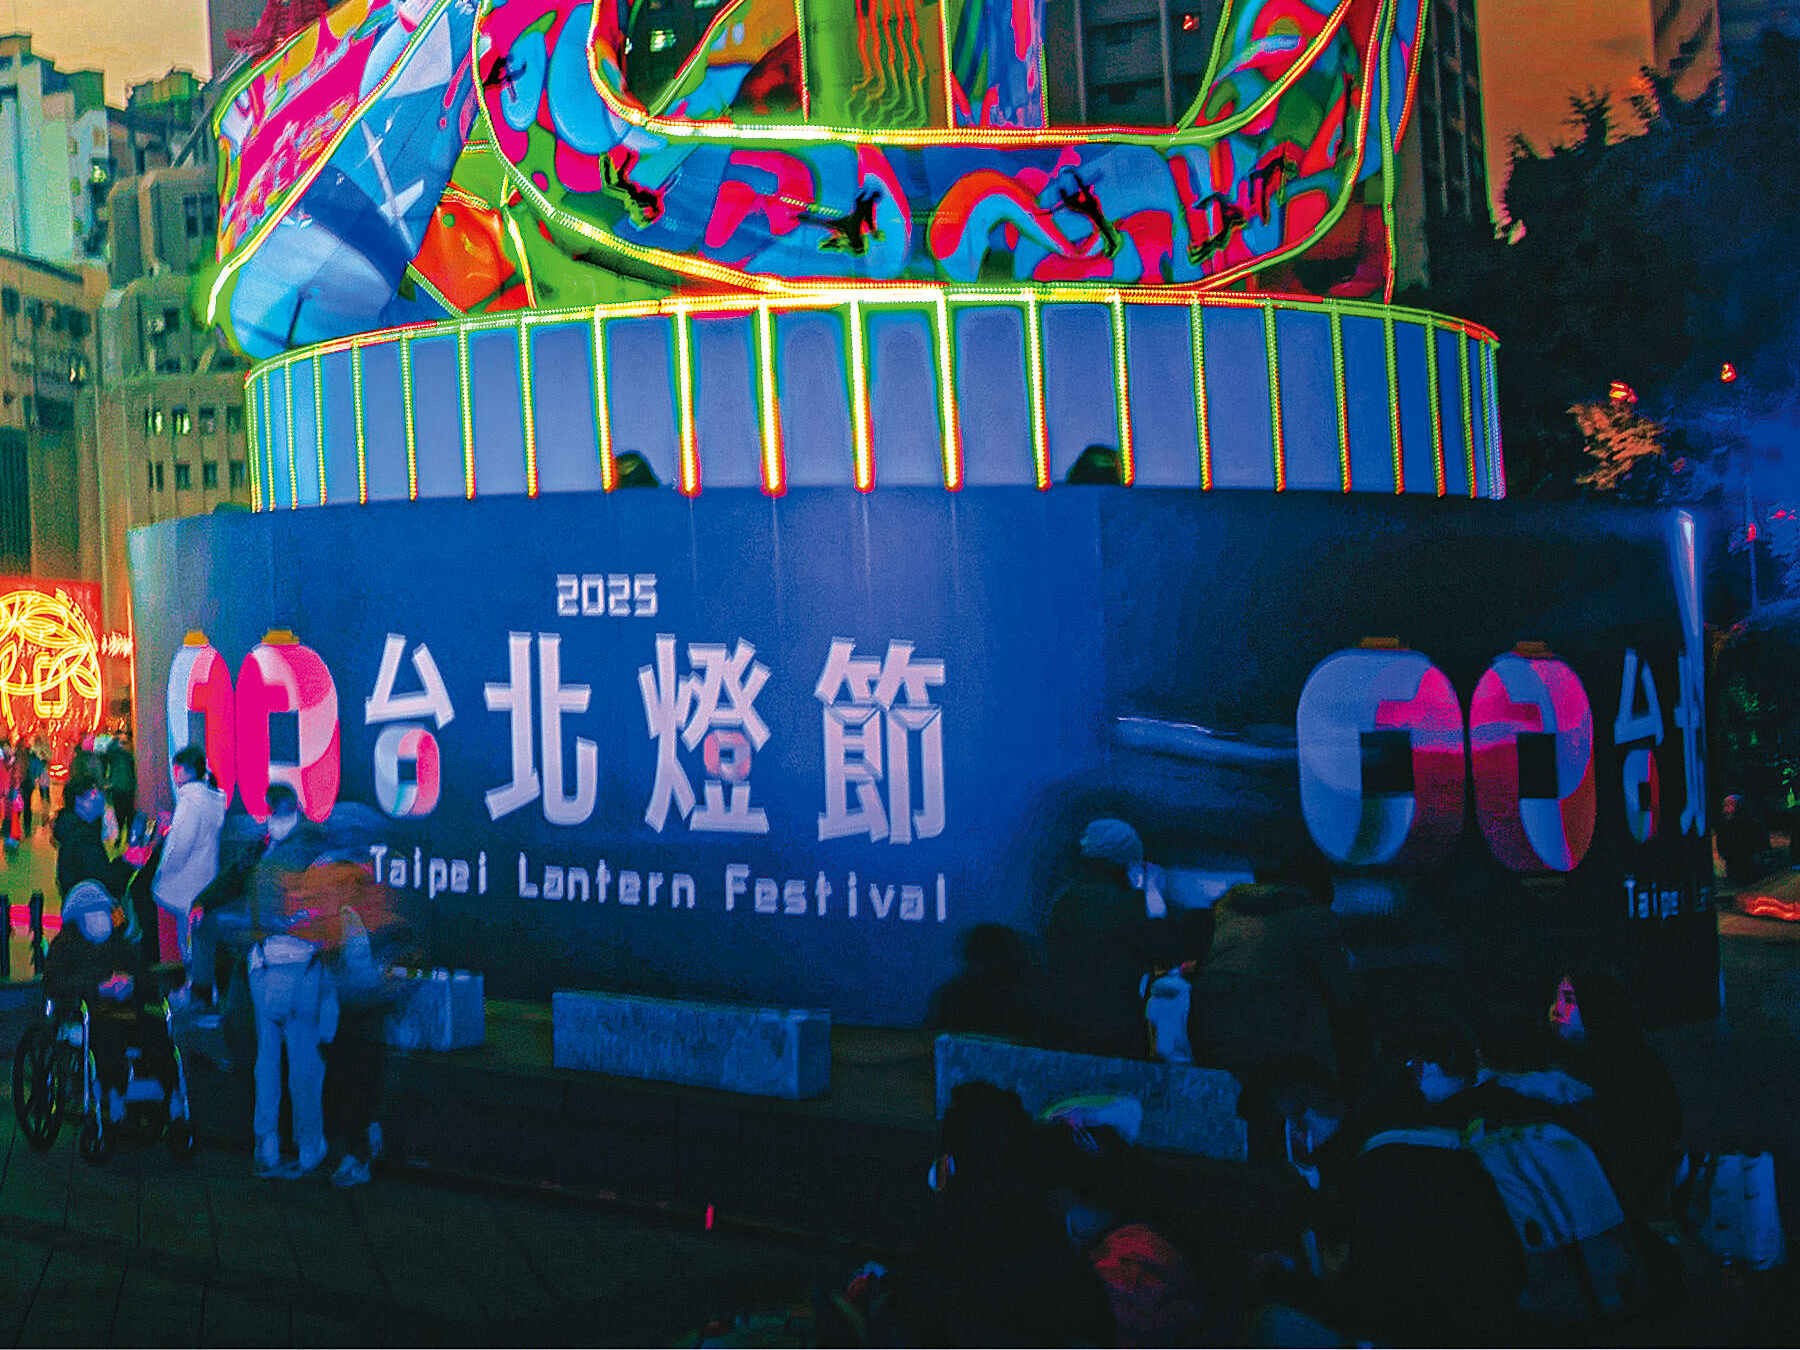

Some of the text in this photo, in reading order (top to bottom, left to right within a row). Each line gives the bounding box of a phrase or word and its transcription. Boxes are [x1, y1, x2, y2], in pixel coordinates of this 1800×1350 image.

[556, 573, 658, 617] 2025
[365, 632, 947, 845] 台北燈節
[369, 845, 948, 922] Taipei Lantern Festival
